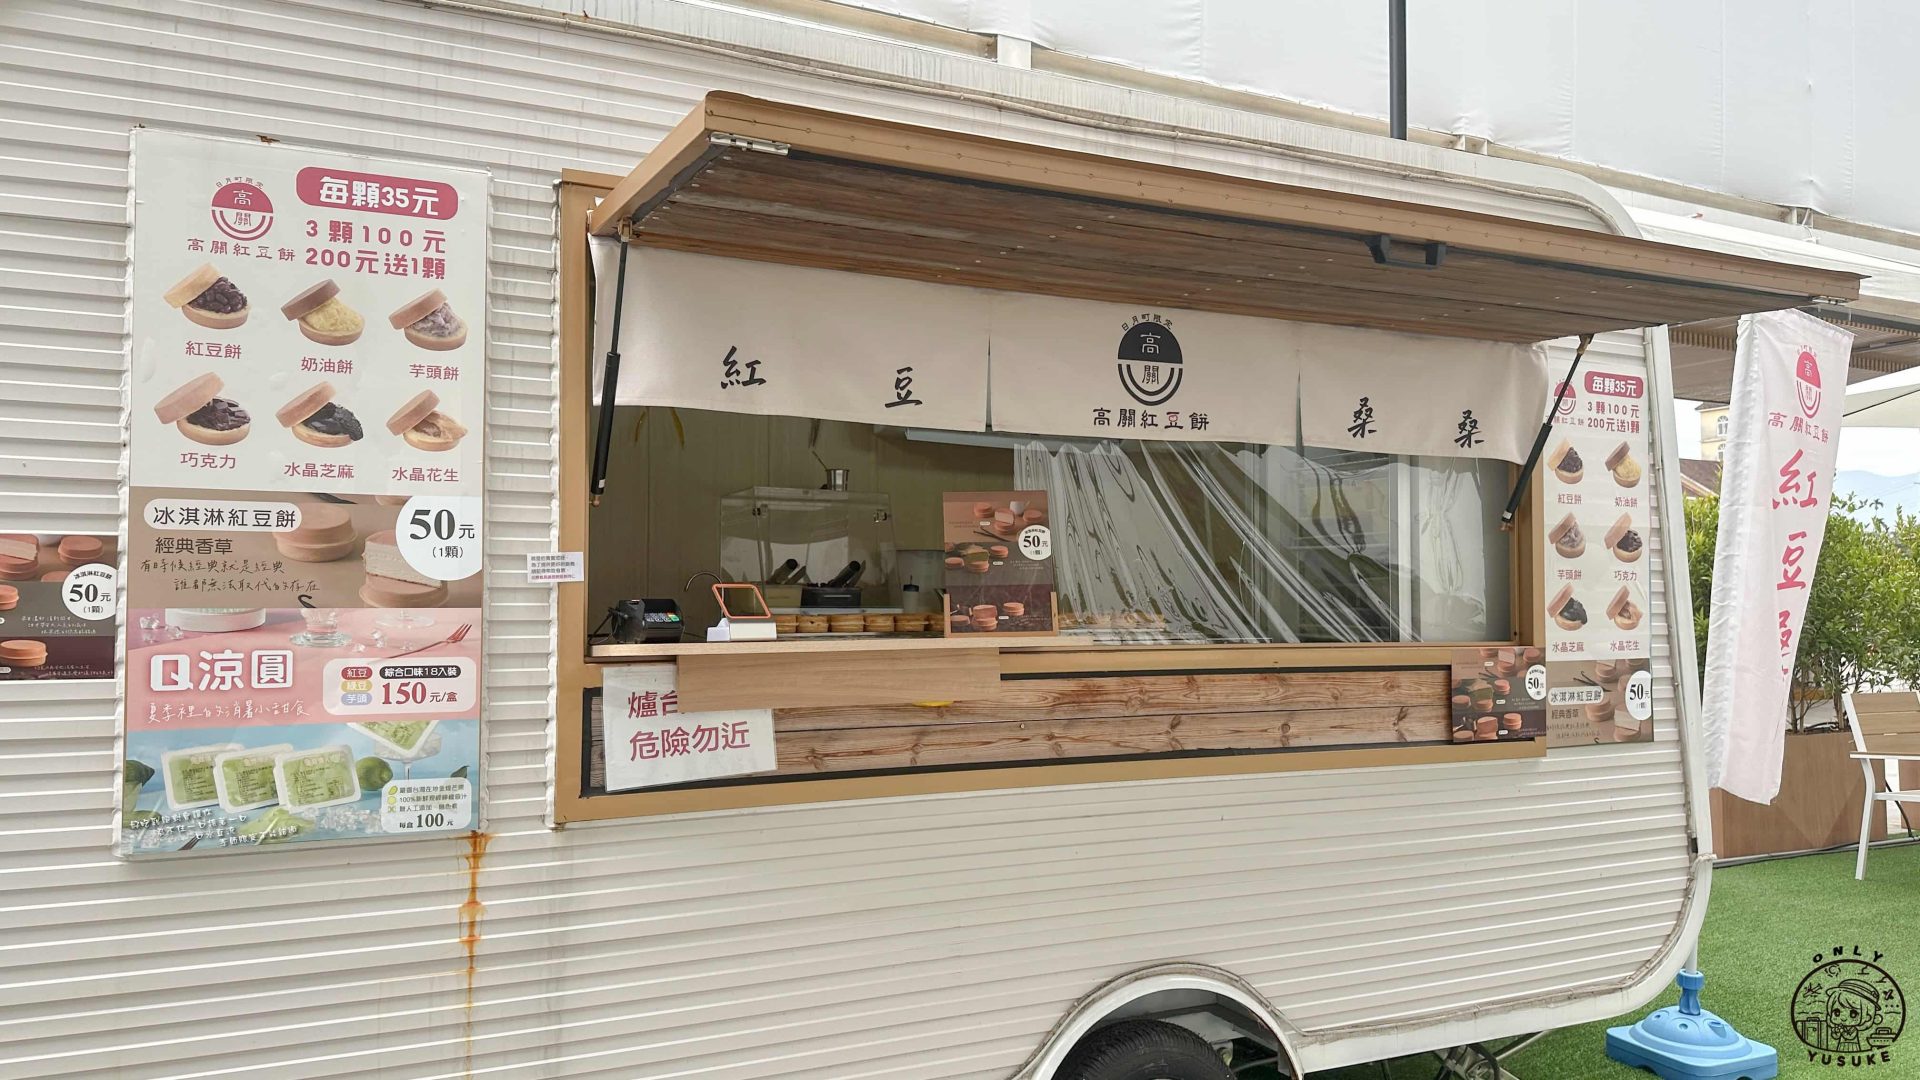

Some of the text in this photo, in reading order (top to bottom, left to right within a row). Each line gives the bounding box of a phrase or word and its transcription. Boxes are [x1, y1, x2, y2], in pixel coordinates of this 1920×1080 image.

[320, 176, 440, 216] 每顆35元
[187, 237, 296, 262] 高關紅豆餅
[305, 248, 446, 280] 200元送1顆
[1121, 313, 1173, 331] 日月町限定
[185, 341, 242, 360] 紅豆餅
[301, 356, 353, 375] 奶油餅
[409, 363, 460, 381] 芋頭餅
[1592, 375, 1637, 397] 每顆35元
[1093, 407, 1210, 431] 高關紅豆餅
[1587, 417, 1640, 434] 200元送1顆
[1768, 411, 1829, 443] 高關紅豆餅
[180, 452, 237, 469] 巧克力
[284, 462, 355, 480] 水晶芝麻
[392, 466, 459, 483] 水晶花生
[1557, 493, 1582, 505] 紅豆餅
[1614, 496, 1638, 508] 奶油餅
[152, 505, 296, 528] 冰淇淋紅豆餅
[409, 508, 475, 541] 50元
[154, 537, 233, 555] 經典香草
[1557, 569, 1582, 580] 芋頭餅
[1614, 570, 1637, 581] 巧克力
[69, 583, 111, 603] 50元
[1552, 640, 1584, 653] 水晶芝麻
[1609, 640, 1640, 651] 水晶花生
[150, 649, 294, 692] Q涼圓
[346, 668, 368, 678] 紅豆
[384, 667, 458, 677] 綜合口味18入裝
[346, 693, 368, 704] 芋頭
[1551, 688, 1601, 702] 冰淇淋紅豆餅
[629, 720, 751, 762] 危險勿近
